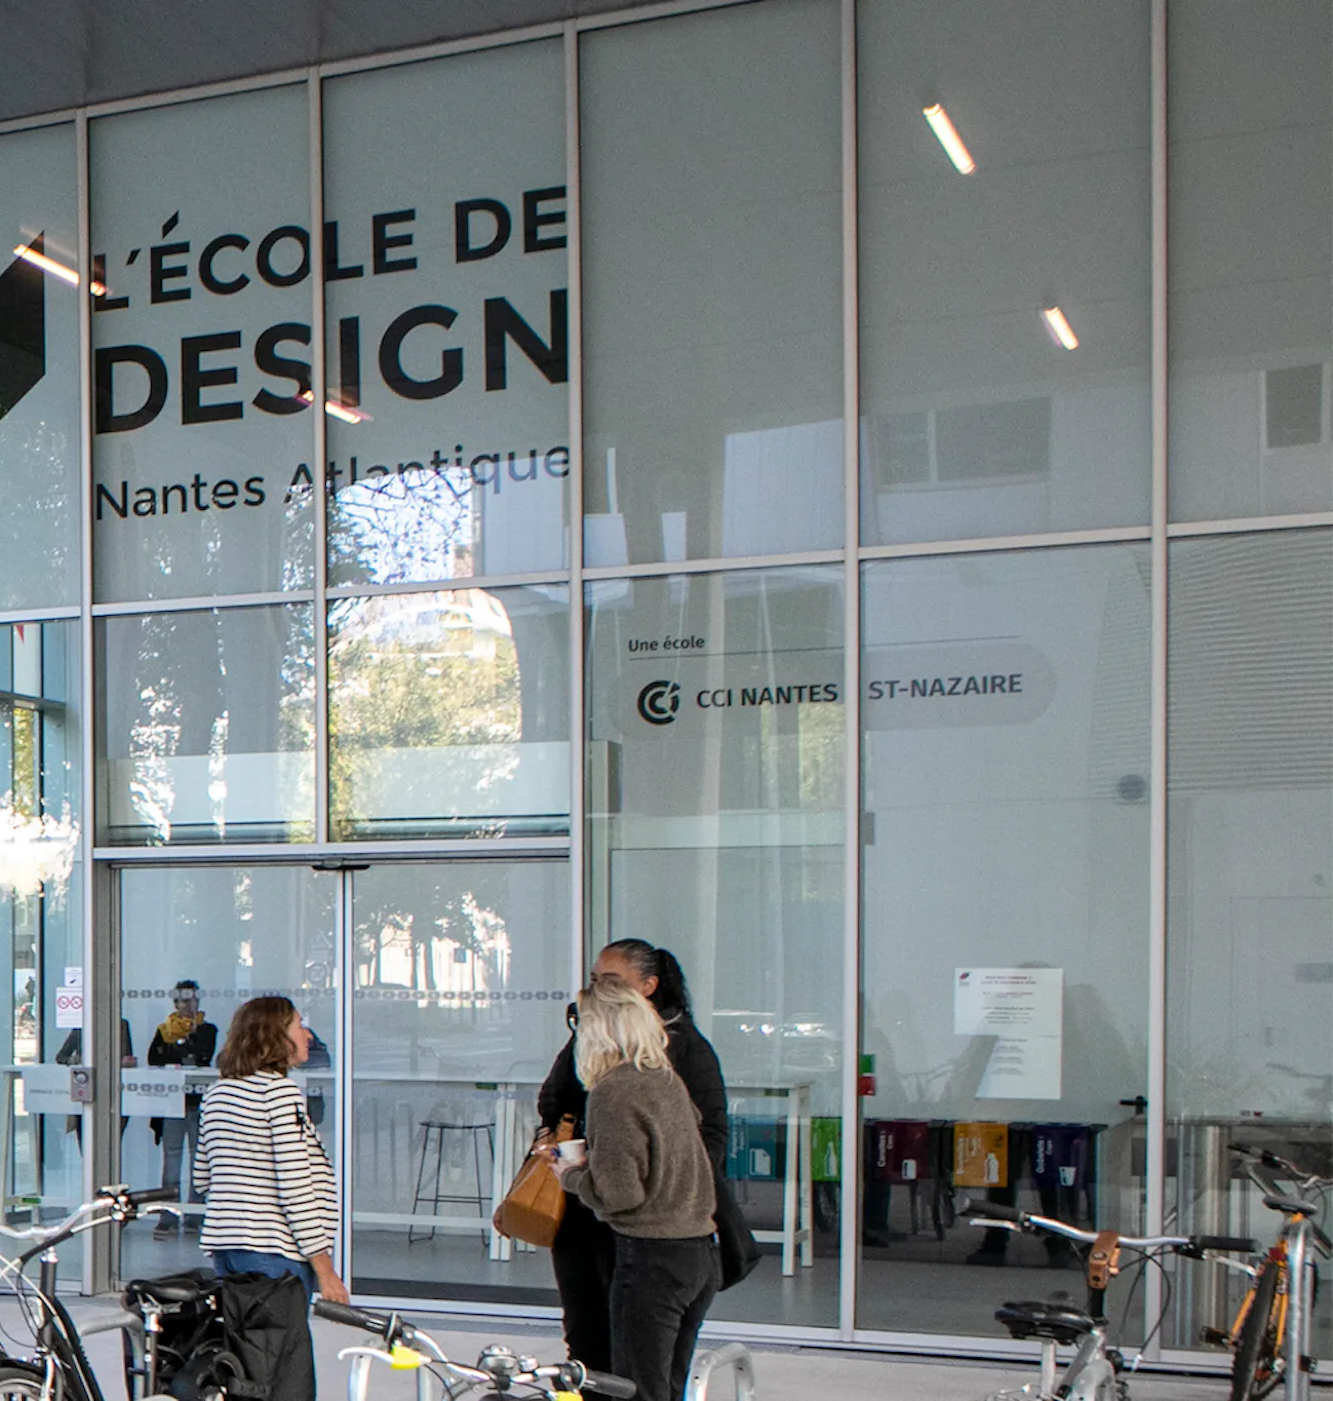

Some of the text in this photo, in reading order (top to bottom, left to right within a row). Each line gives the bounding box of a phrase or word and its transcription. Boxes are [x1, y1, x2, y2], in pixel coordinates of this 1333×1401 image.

[93, 185, 568, 313] L'ÉCOLE DE
[94, 287, 569, 435] DESIGN
[95, 473, 266, 520] Nantes
[628, 635, 705, 652] Une école
[696, 673, 1023, 708] CCI NANTES ST-NAZAIRE
